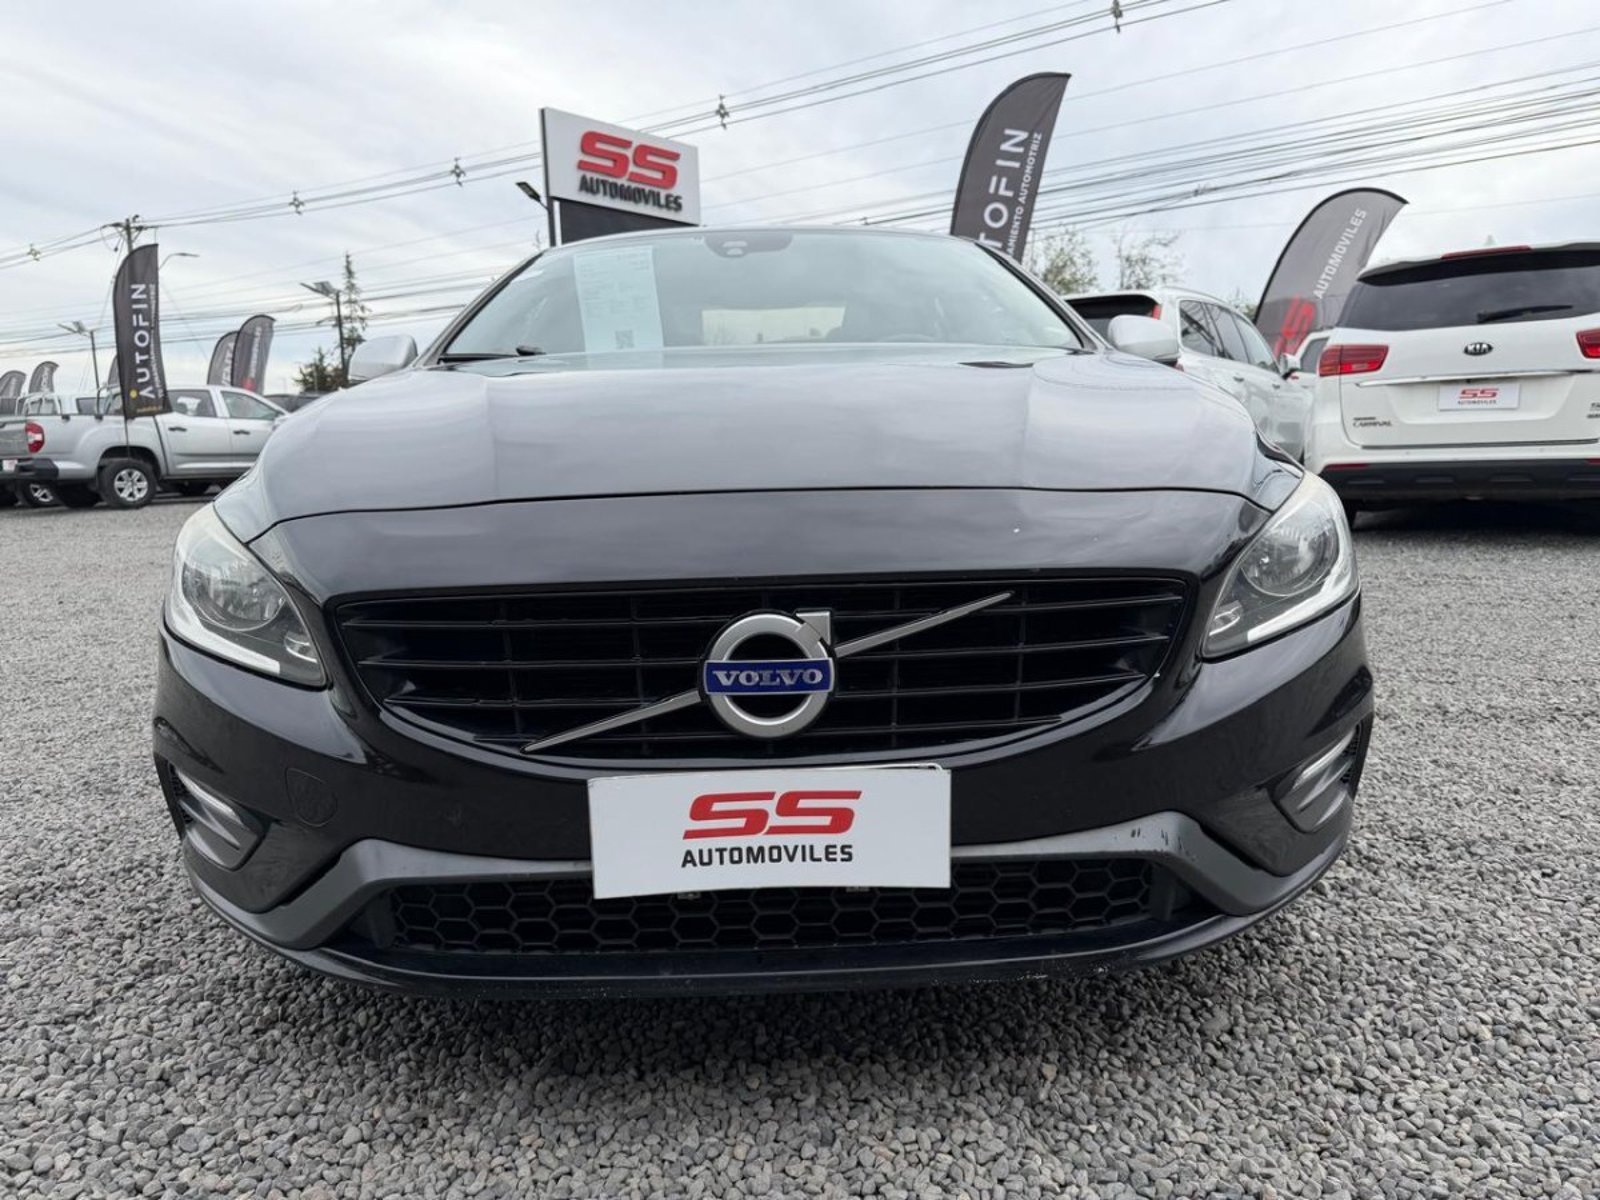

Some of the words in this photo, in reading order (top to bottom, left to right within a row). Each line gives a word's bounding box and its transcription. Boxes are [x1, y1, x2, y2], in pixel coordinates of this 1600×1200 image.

[577, 130, 681, 190] SS
[1017, 132, 1042, 205] AUTOMOTRIZ
[578, 173, 682, 212] AUTOMOVILES
[979, 128, 1029, 249] TOFIN
[1313, 207, 1367, 299] AUTOMOVILES
[130, 283, 156, 399] AUTOFIN
[1467, 343, 1489, 353] KIA
[1460, 388, 1499, 400] SS
[712, 668, 824, 687] VOLVO
[682, 790, 862, 840] SS
[681, 843, 854, 868] AUTOMOVILES
